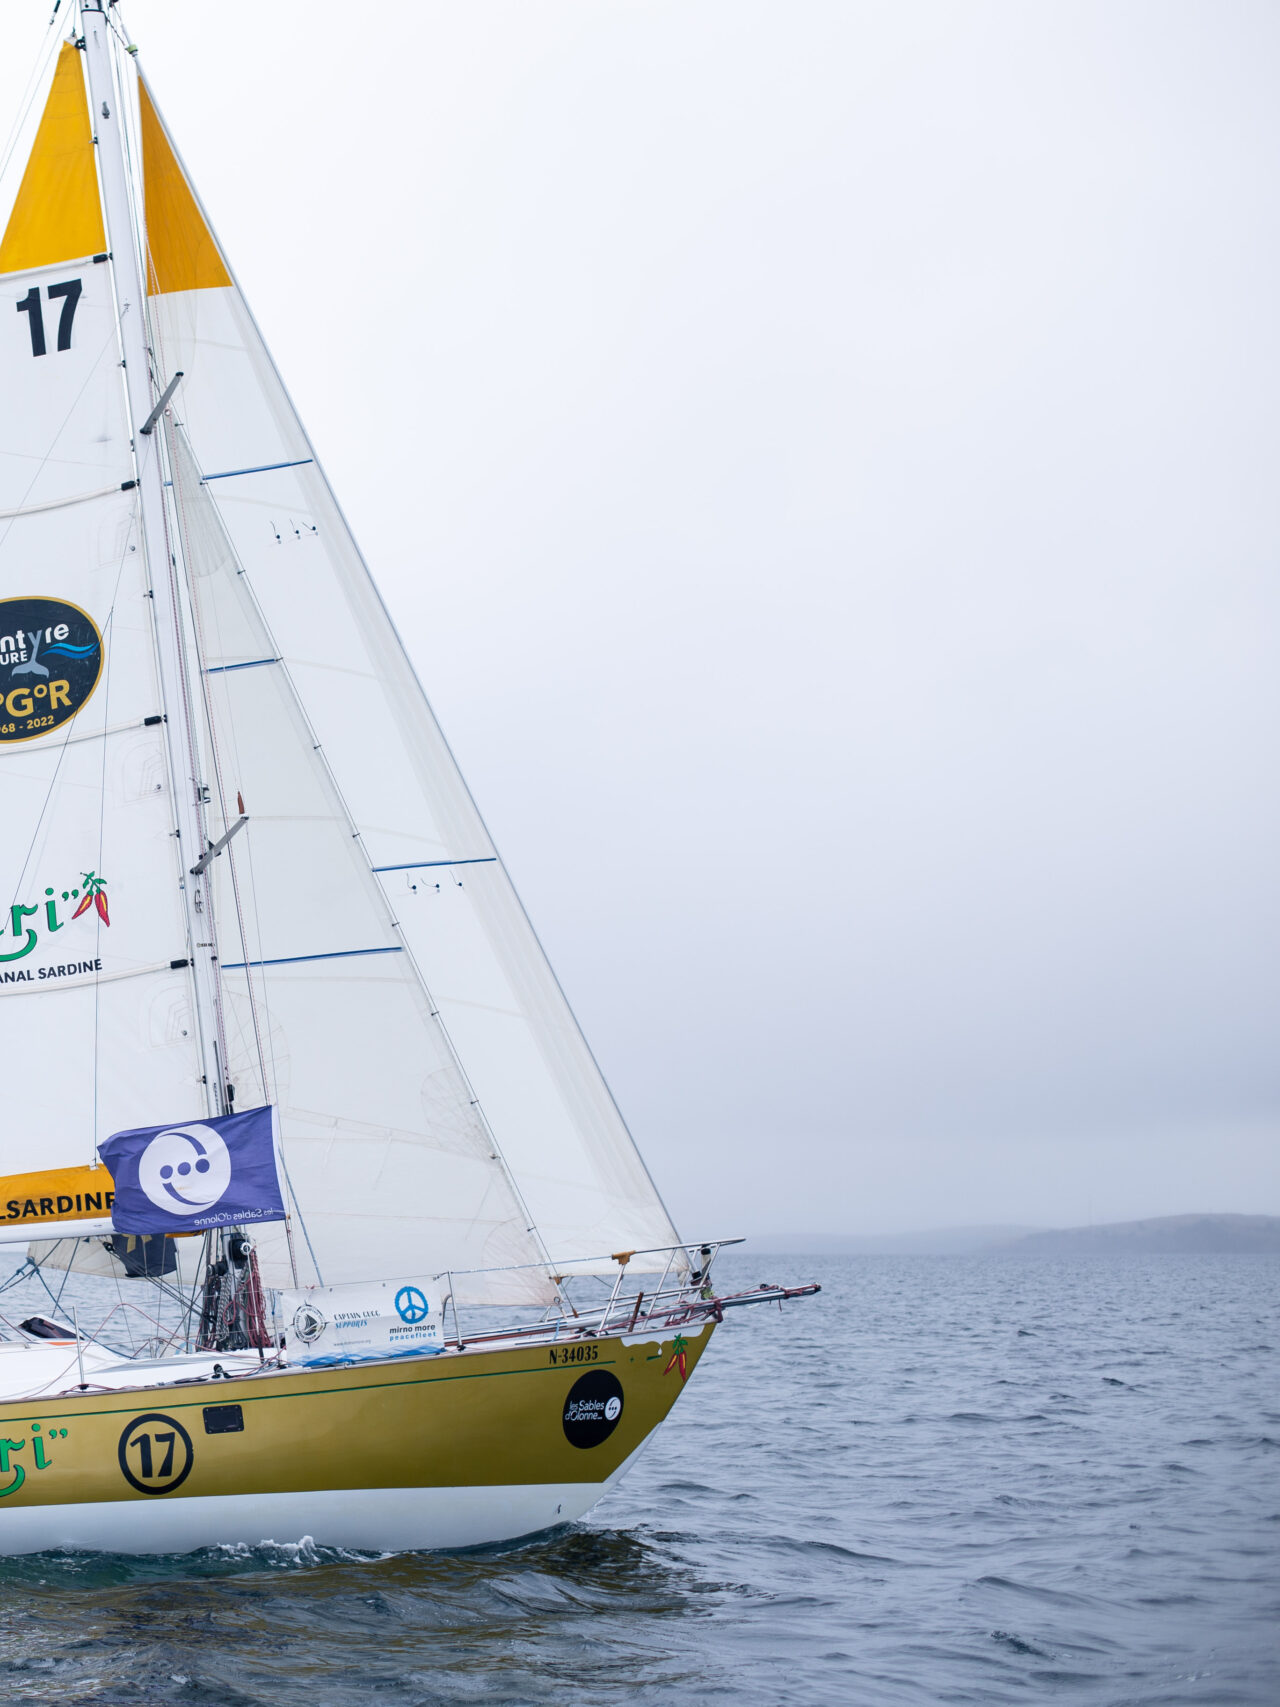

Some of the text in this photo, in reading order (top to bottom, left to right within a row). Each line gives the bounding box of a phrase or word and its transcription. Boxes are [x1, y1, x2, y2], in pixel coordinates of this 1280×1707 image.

[16, 278, 83, 357] 17
[26, 715, 55, 730] 2022
[38, 958, 103, 980] SARDINE
[389, 1324, 436, 1334] mirno more
[389, 1331, 436, 1342] peacefleet
[549, 1345, 599, 1365] N-34035
[569, 1399, 605, 1411] les Sables
[129, 1431, 176, 1478] 17
